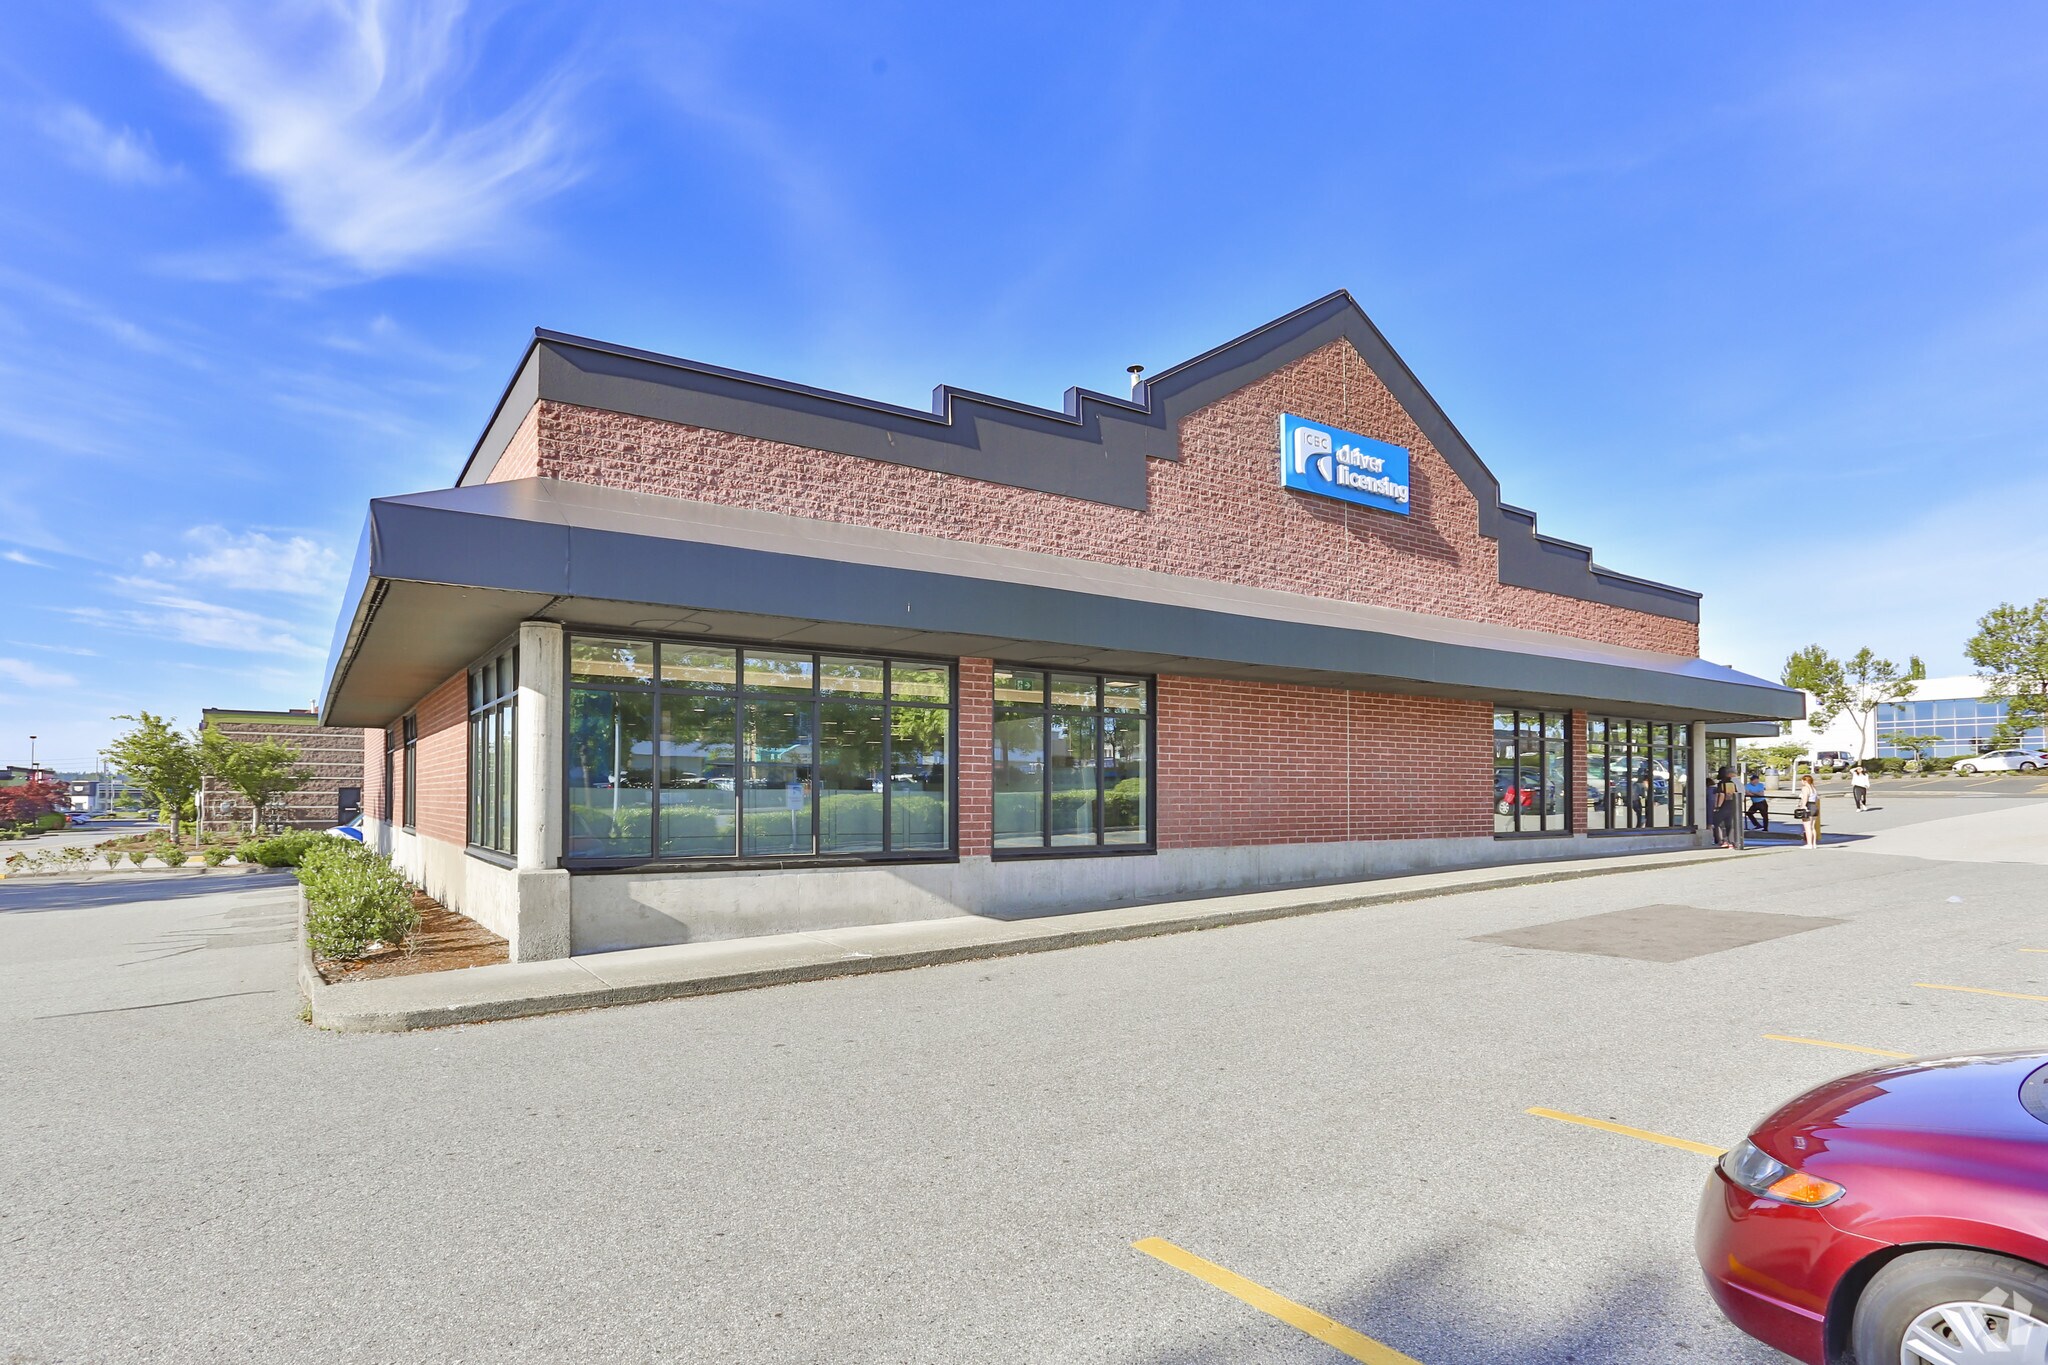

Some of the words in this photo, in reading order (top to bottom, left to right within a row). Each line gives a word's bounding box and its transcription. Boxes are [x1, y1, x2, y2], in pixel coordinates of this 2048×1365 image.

[1303, 432, 1328, 449] ICBC
[1336, 444, 1385, 473] driver
[1337, 464, 1409, 503] licensing
